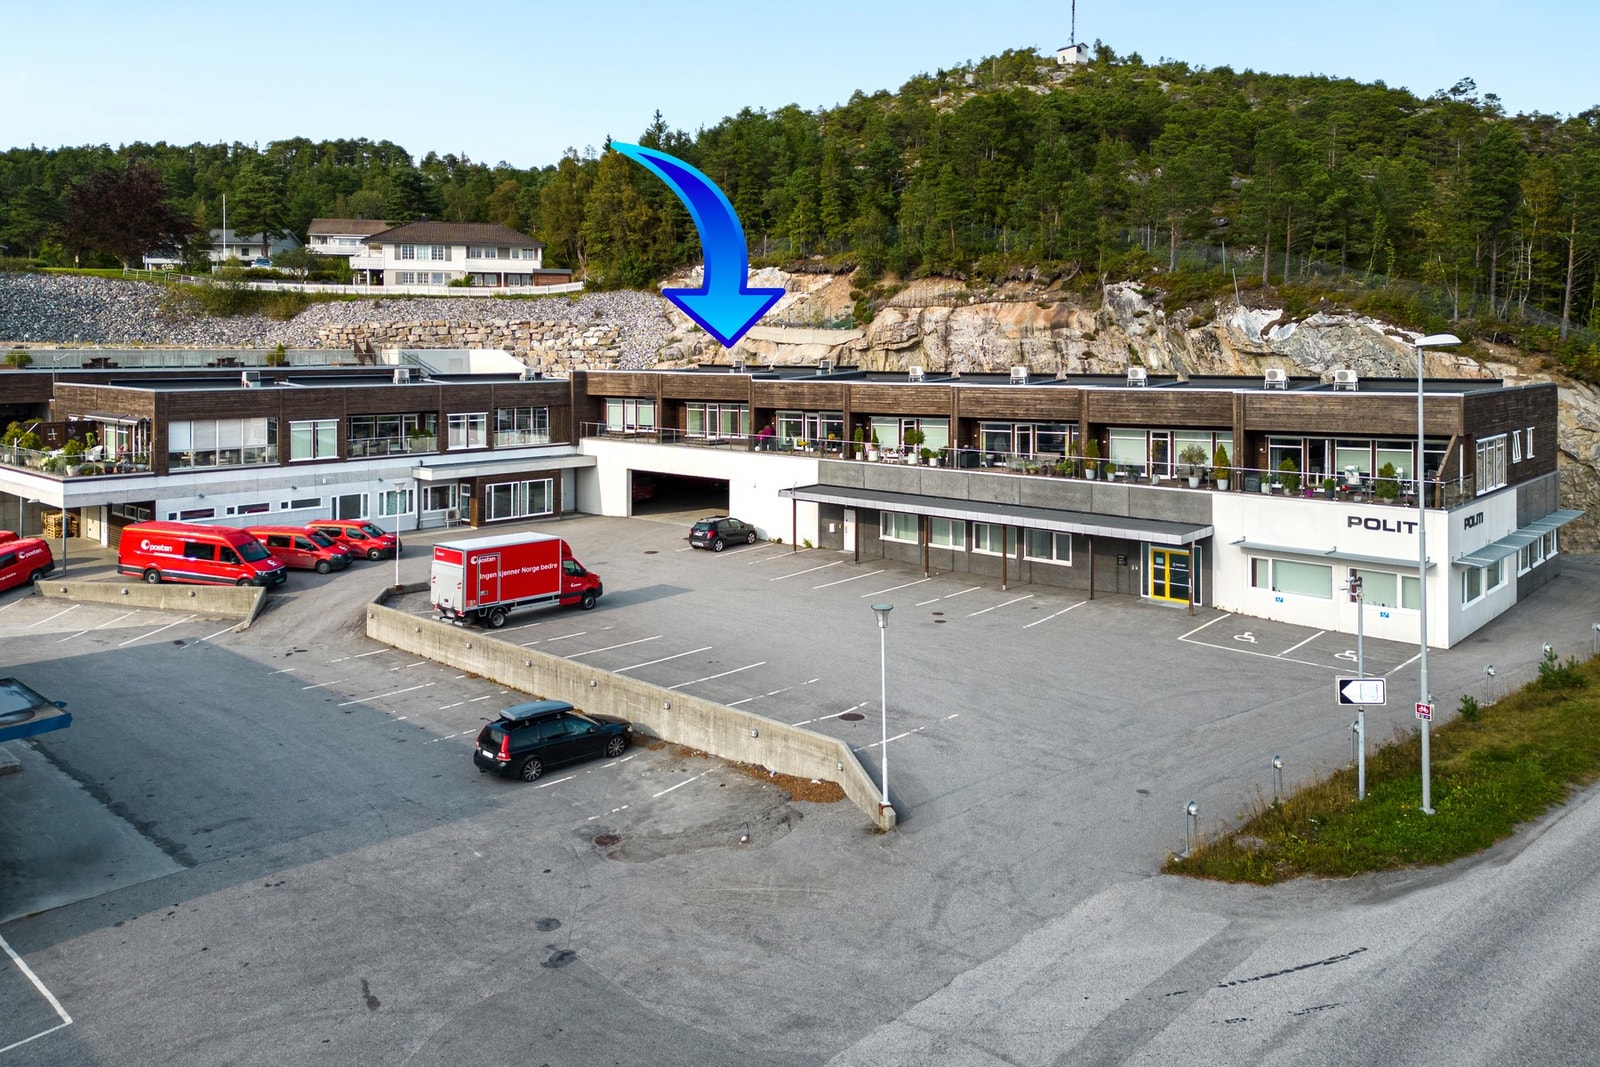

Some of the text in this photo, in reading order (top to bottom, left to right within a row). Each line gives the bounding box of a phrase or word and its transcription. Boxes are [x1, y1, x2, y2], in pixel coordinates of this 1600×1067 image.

[1347, 515, 1419, 534] POLIT
[25, 548, 43, 558] posten
[149, 544, 173, 552] posten
[480, 572, 498, 581] Ingen
[521, 564, 540, 573] Norge
[540, 562, 558, 571] bedre
